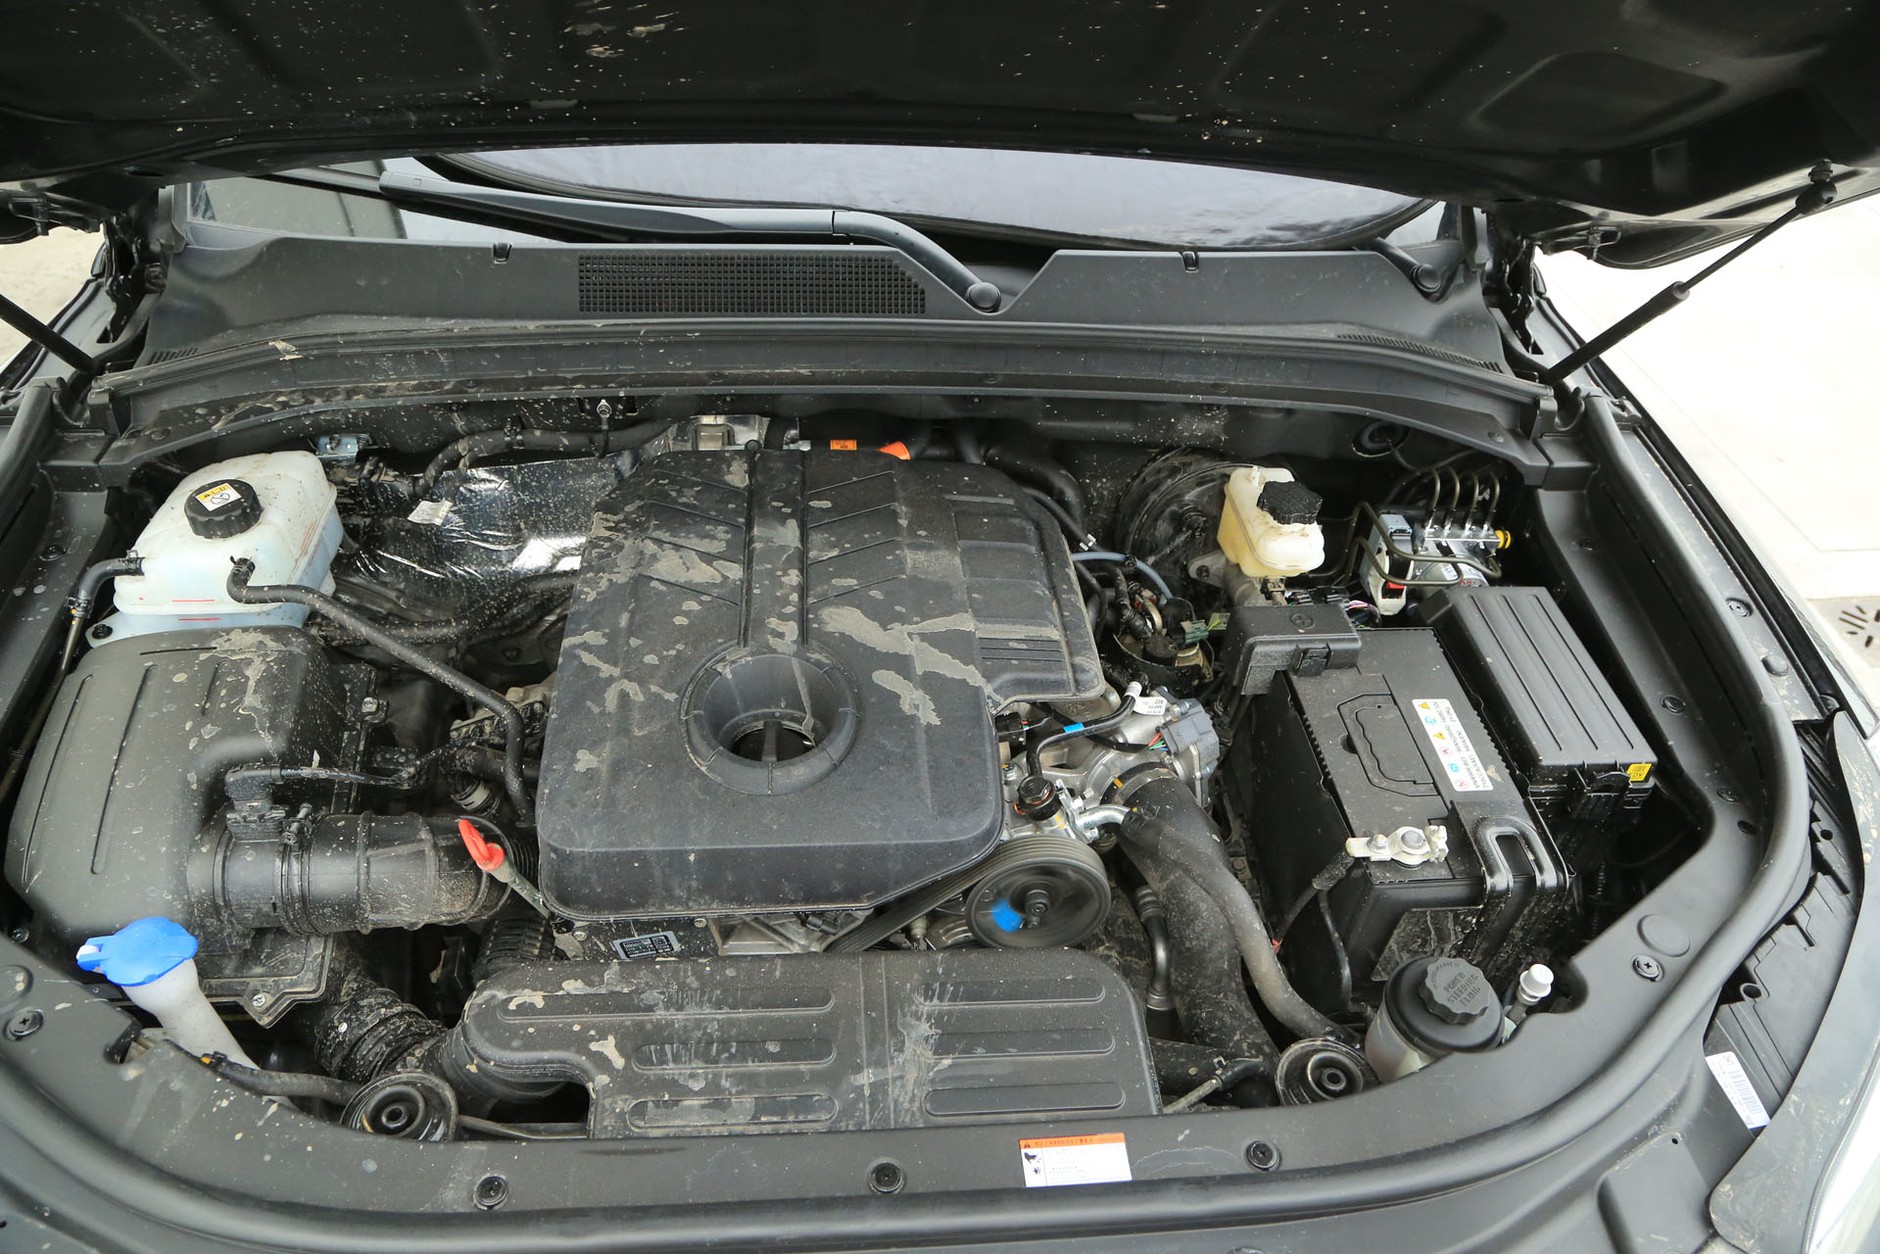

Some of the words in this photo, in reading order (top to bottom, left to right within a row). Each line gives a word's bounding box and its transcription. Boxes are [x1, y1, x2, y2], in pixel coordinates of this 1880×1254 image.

[1444, 972, 1467, 993] POWER
[1448, 974, 1479, 1004] STEERING
[1460, 985, 1481, 1006] FLUID
